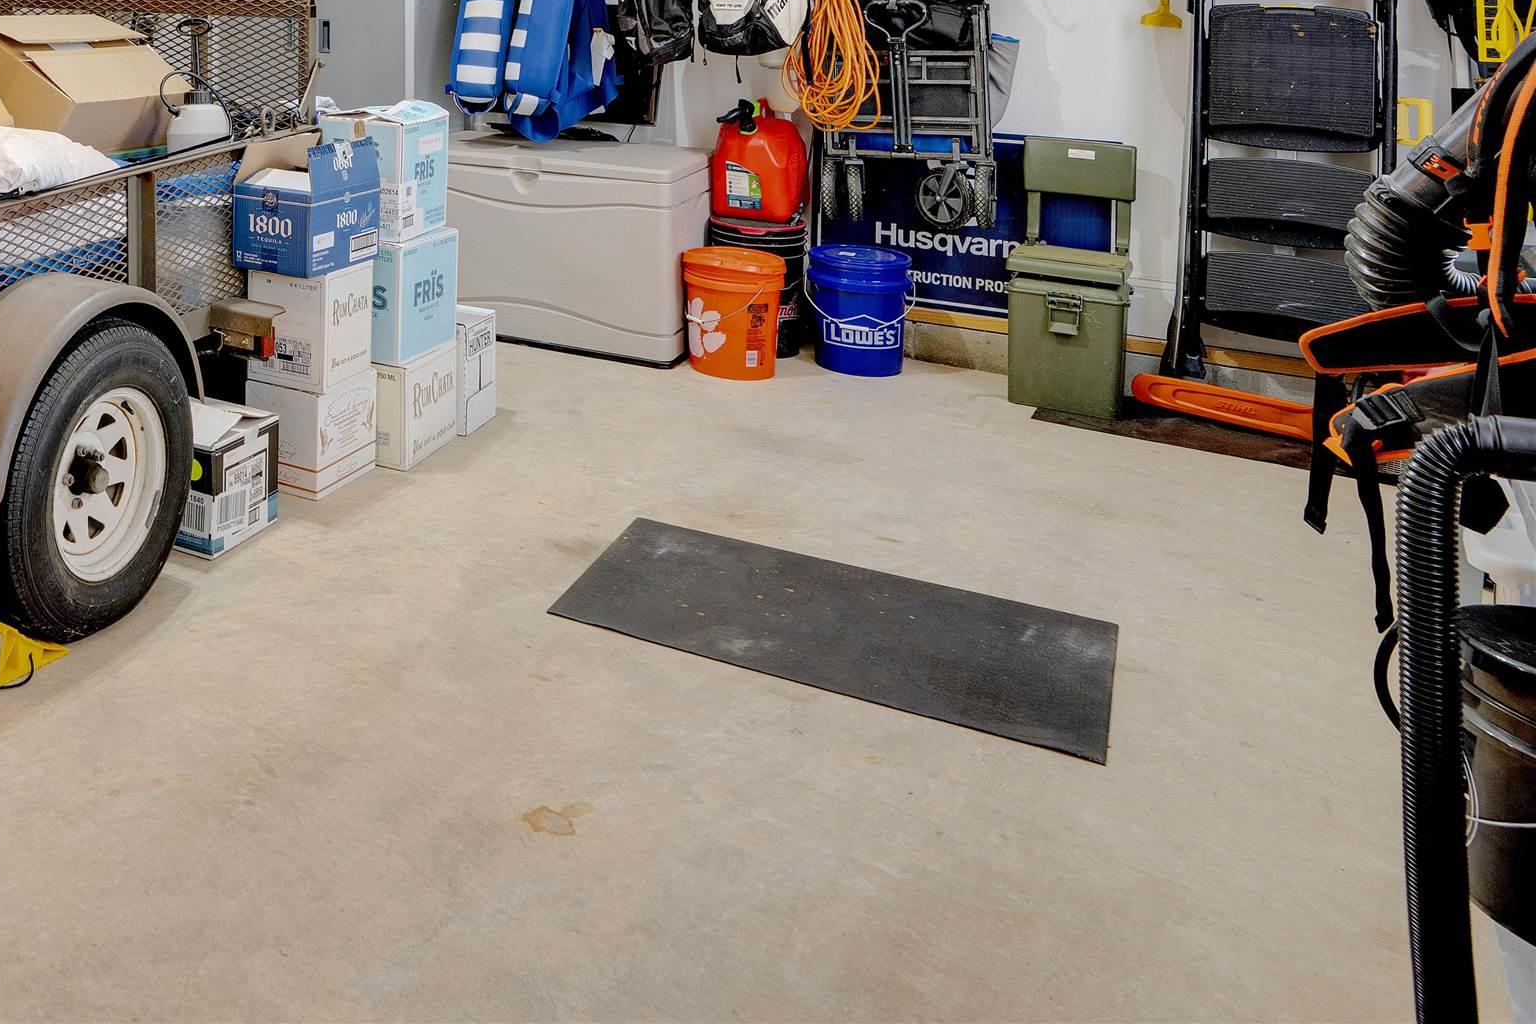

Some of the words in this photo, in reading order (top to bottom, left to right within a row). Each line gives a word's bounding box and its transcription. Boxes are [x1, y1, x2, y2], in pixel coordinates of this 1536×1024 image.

[248, 213, 292, 239] 1800
[336, 209, 358, 229] 1800
[256, 236, 283, 245] TEQUILA
[875, 221, 1021, 259] Husqvarn
[830, 323, 895, 346] LOWE'S
